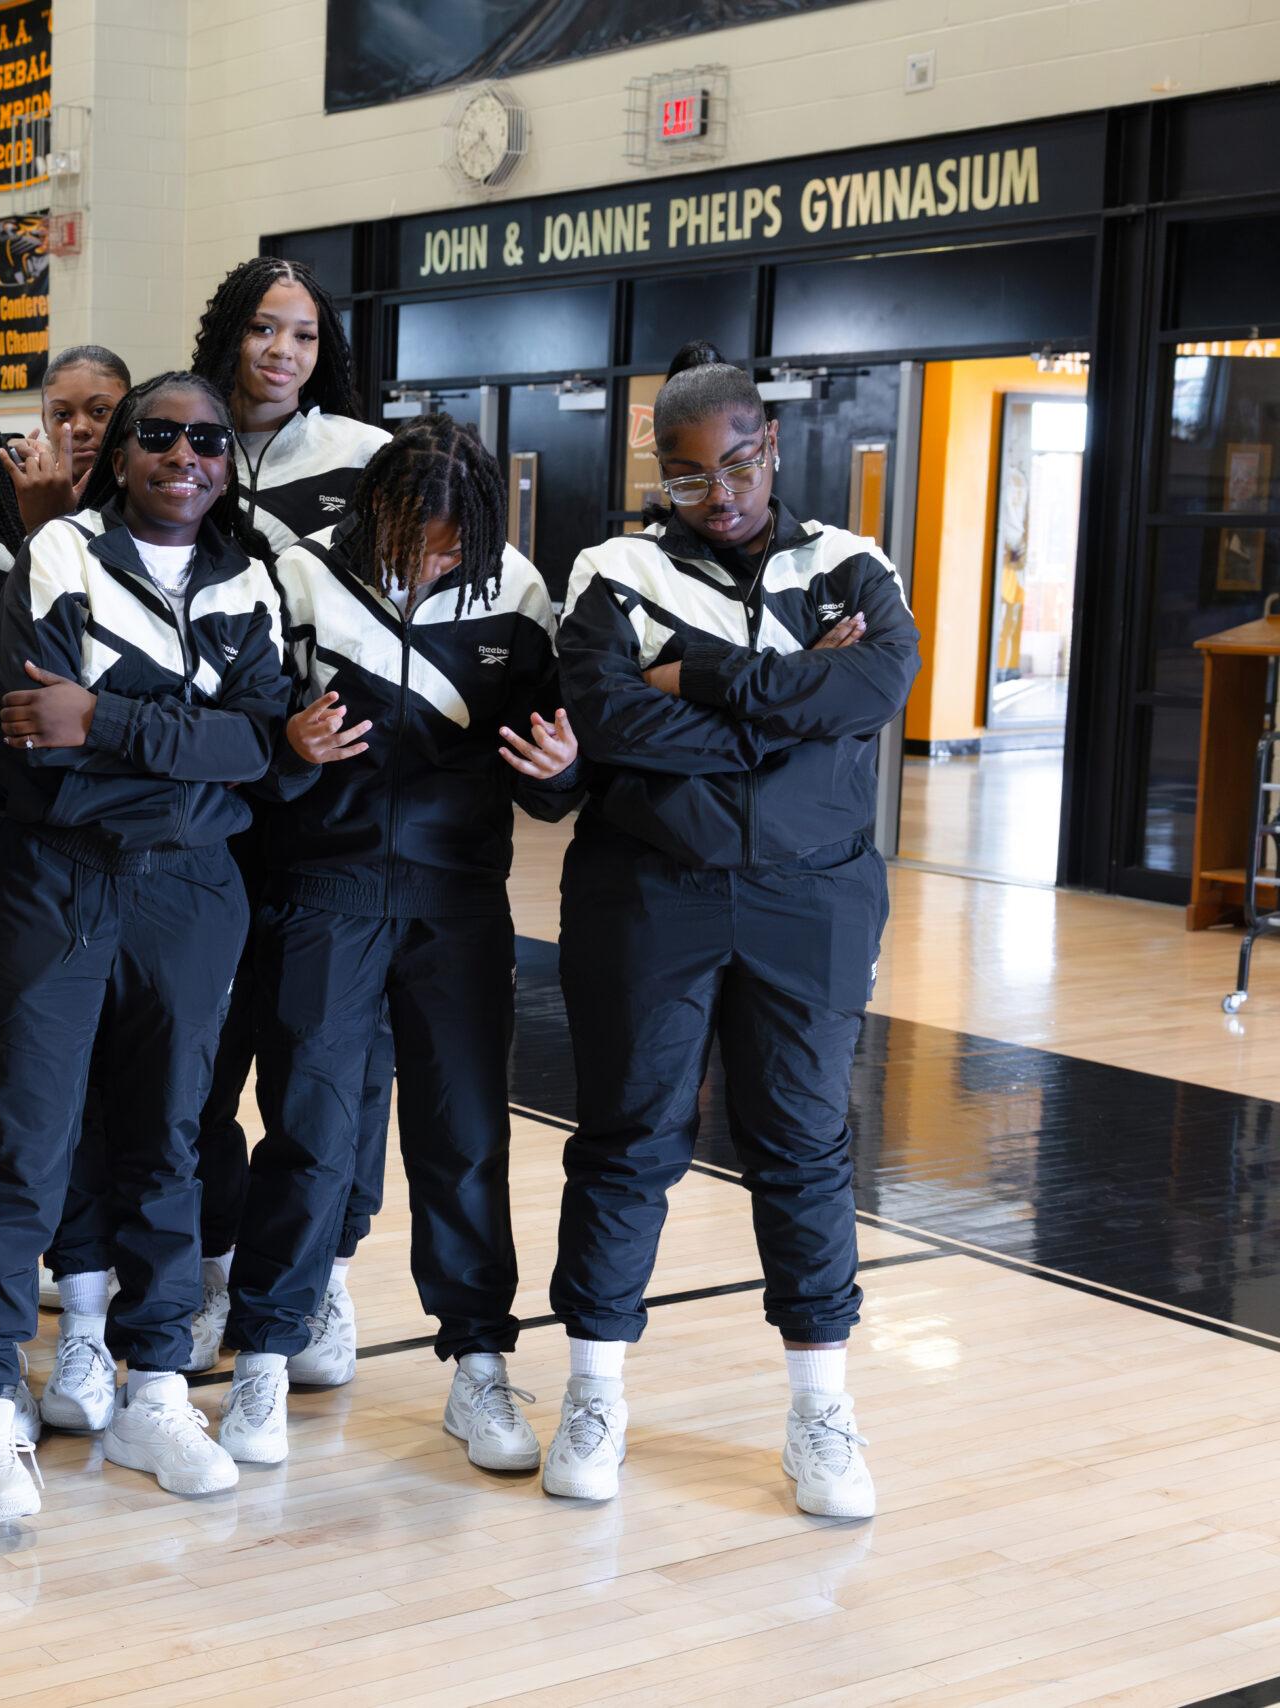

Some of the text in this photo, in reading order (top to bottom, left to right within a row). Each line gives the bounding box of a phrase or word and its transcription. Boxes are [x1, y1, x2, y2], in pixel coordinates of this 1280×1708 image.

[663, 97, 694, 136] EXIT
[420, 147, 1038, 276] JOHN & JOANNE PHELPS GYMNASIUM
[0, 294, 48, 320] Confere
[6, 326, 48, 354] Champi
[0, 364, 27, 390] 2016
[479, 646, 509, 654] Reebo
